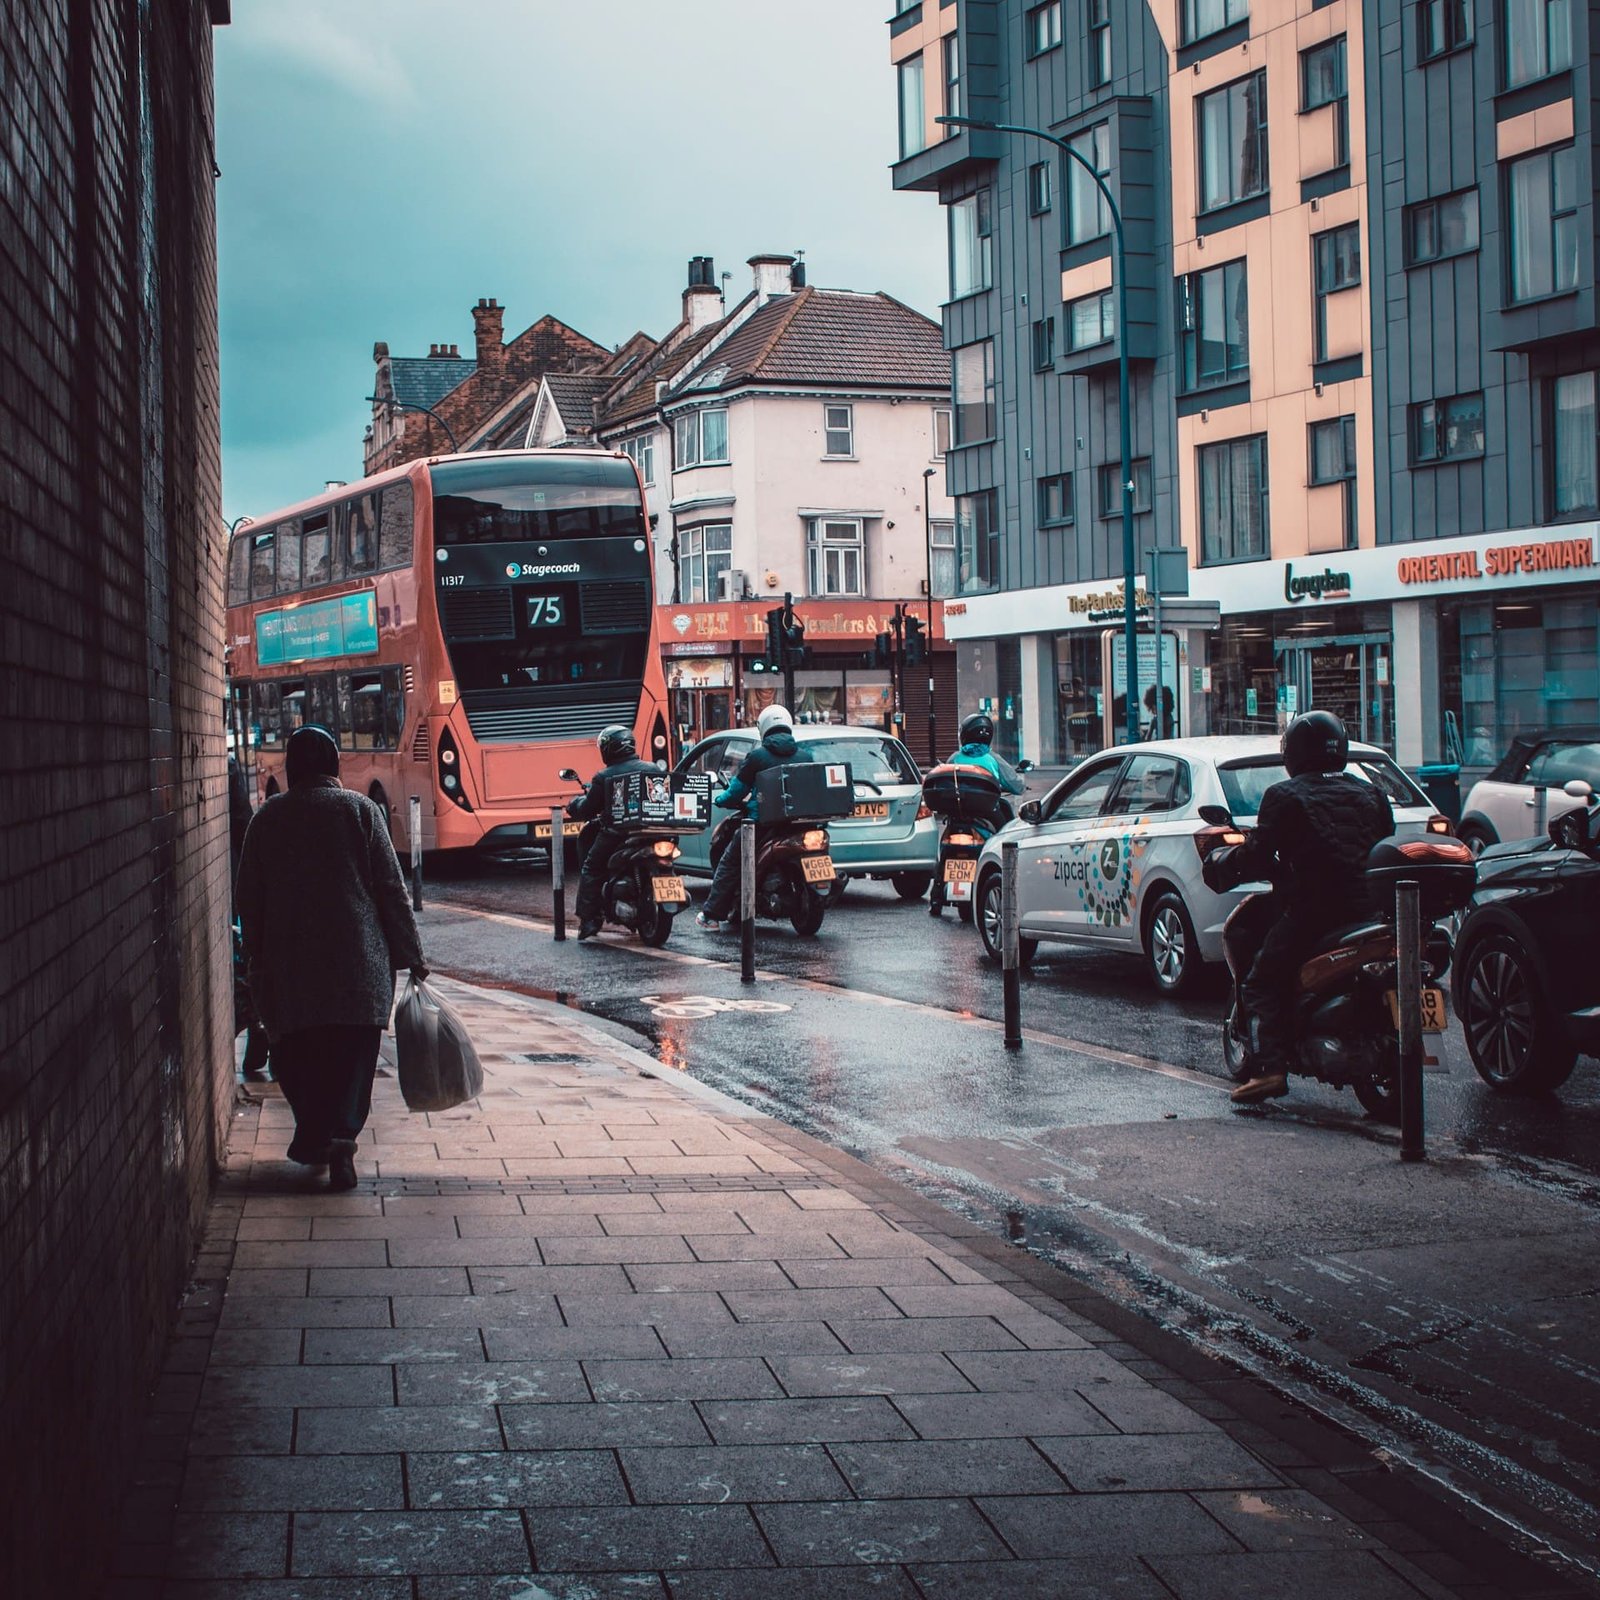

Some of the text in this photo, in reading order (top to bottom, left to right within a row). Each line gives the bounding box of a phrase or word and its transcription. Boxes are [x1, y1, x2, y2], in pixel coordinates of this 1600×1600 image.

[522, 562, 580, 576] Stagecoach
[1398, 551, 1481, 584] ORIENTAL
[441, 575, 465, 586] 11317
[1285, 562, 1351, 602] Longdan
[528, 596, 561, 625] 75
[1067, 595, 1086, 613] The
[866, 615, 877, 633] &
[692, 677, 709, 686] TJT
[829, 768, 842, 784] L
[679, 796, 693, 816] L
[864, 803, 883, 815] AVC
[564, 823, 582, 832] PCV
[809, 868, 831, 880] RYU
[1054, 854, 1090, 887] zipcar
[659, 890, 681, 899] LPN
